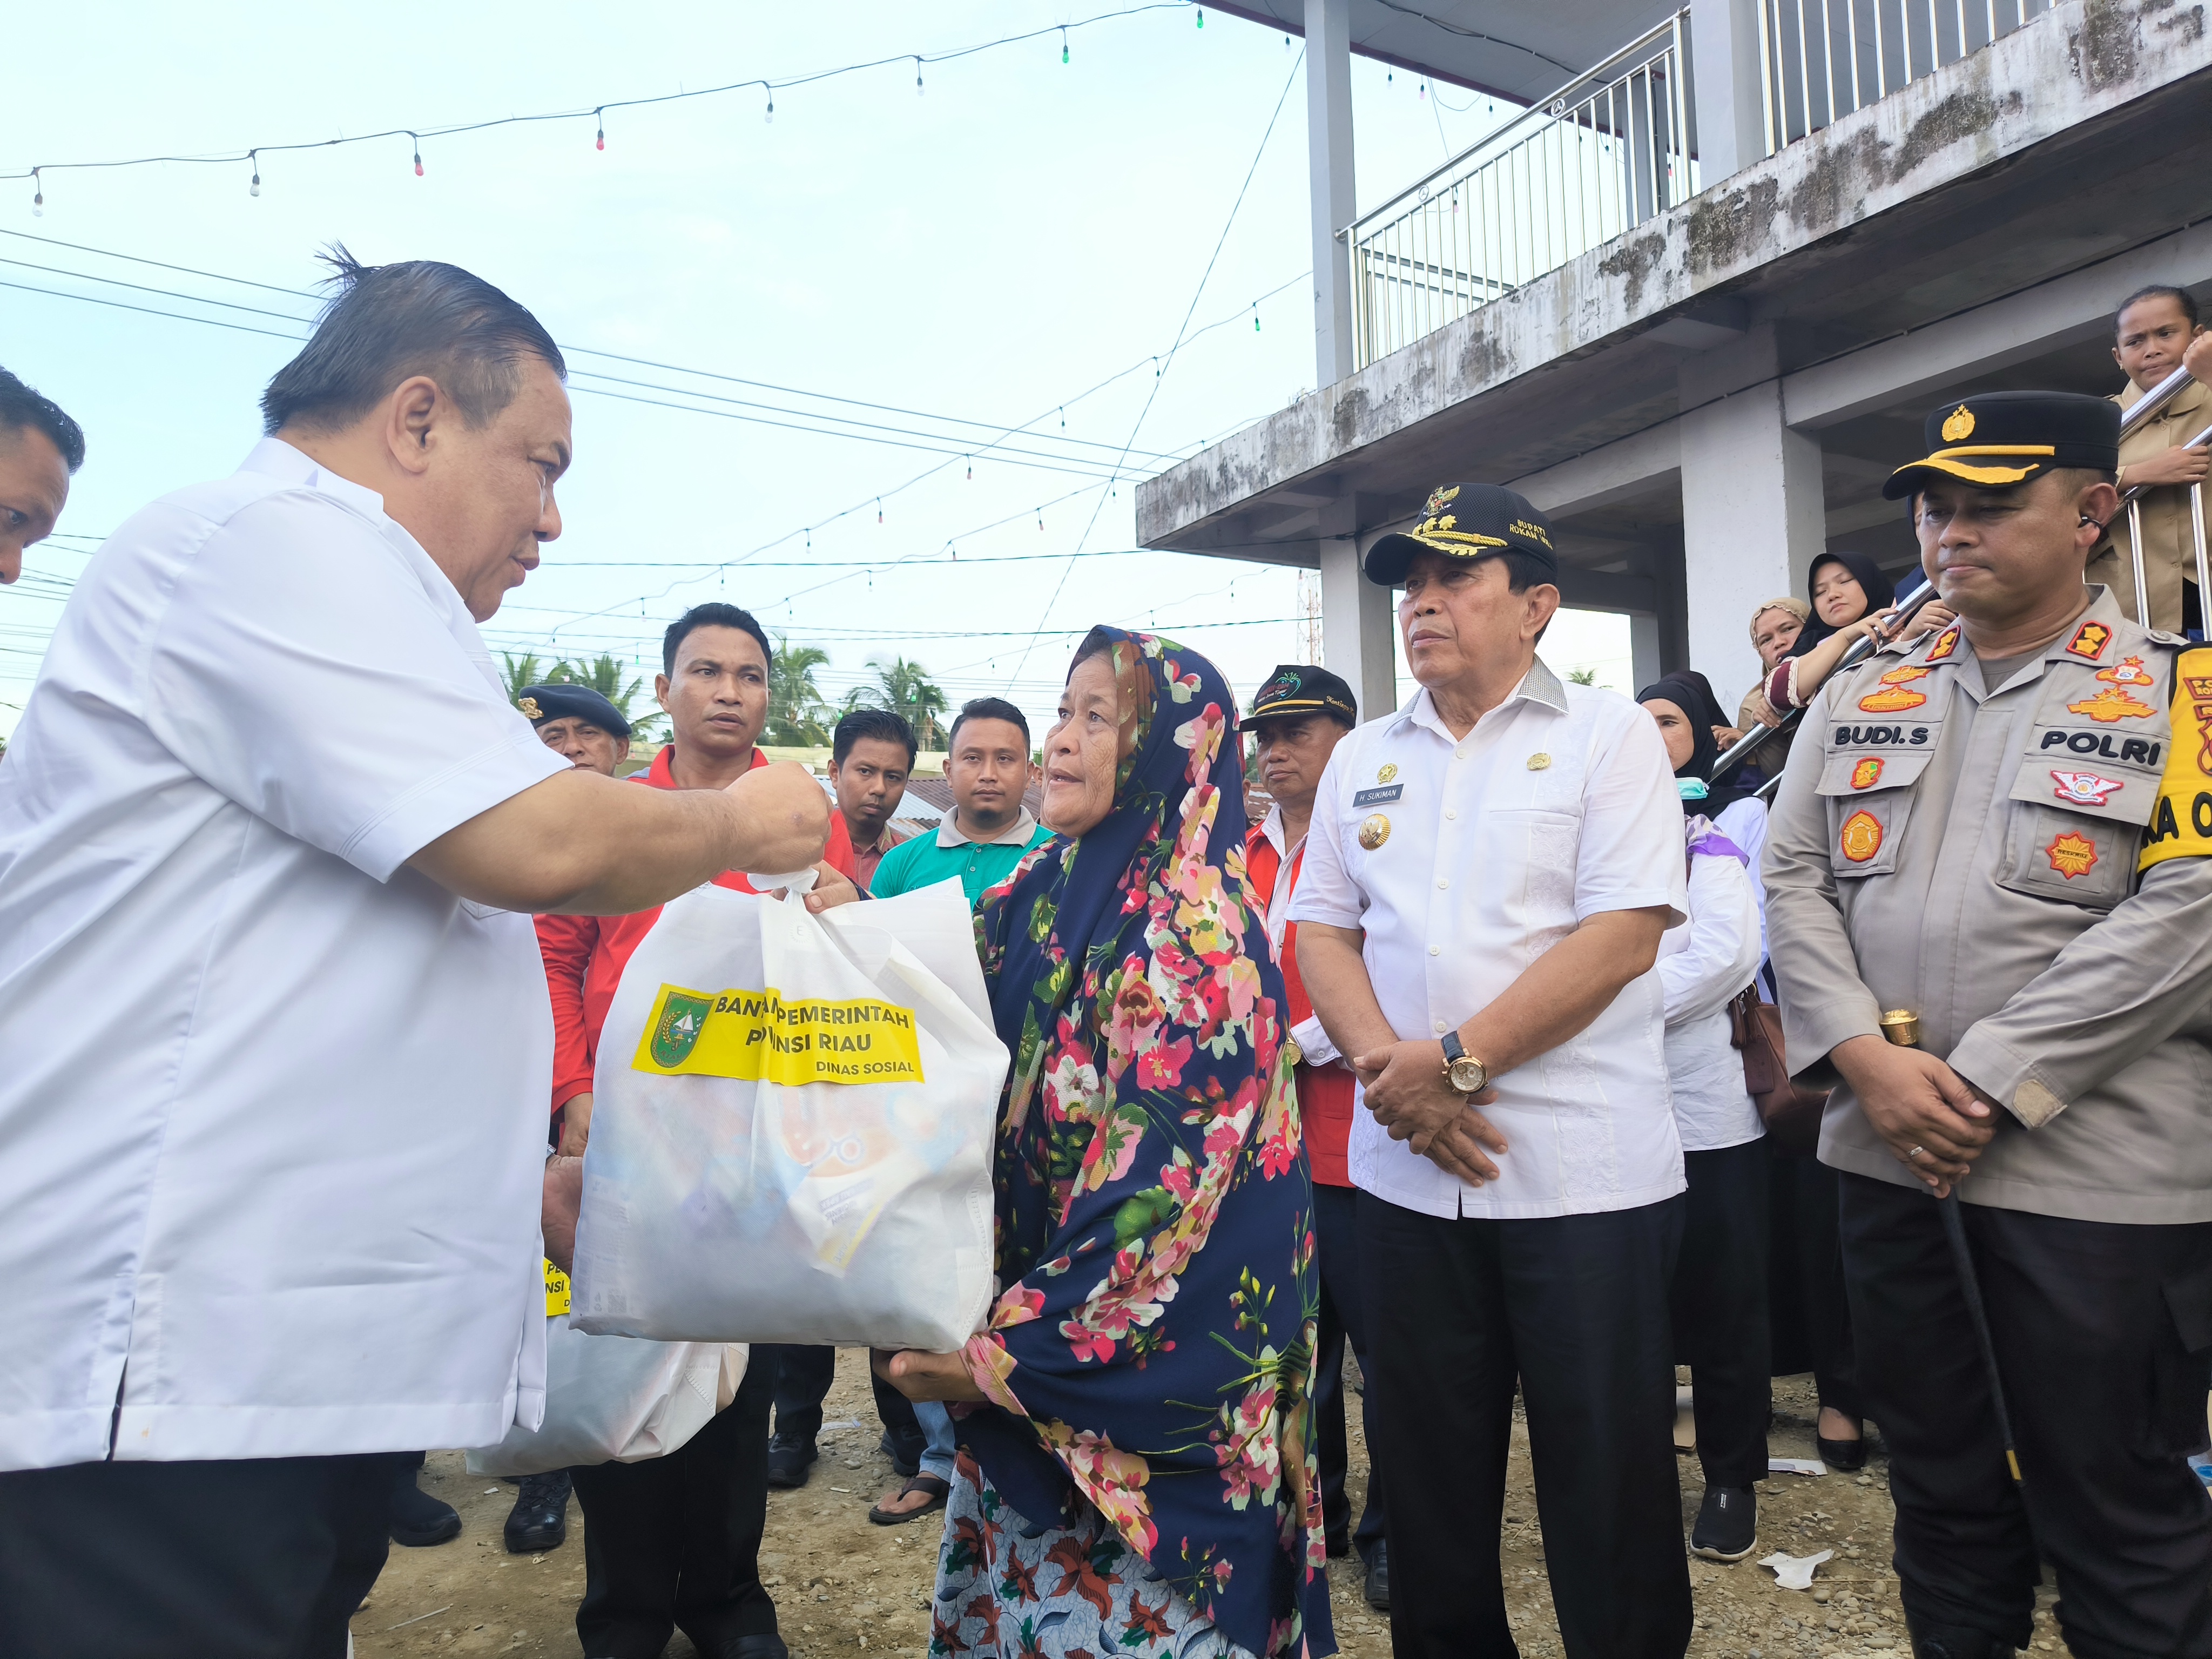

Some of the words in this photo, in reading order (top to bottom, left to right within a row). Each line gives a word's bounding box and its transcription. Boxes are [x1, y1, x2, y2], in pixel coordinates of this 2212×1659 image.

[1509, 523, 1538, 540] ROKAN
[1517, 519, 1546, 537] BUPATI
[2040, 731, 2161, 766] POLRI
[1367, 789, 1397, 801] SUKIMAN
[777, 1006, 909, 1029] PEMERINTAH
[819, 1033, 871, 1052] RIAU
[816, 1061, 859, 1075] DINAS
[863, 1061, 914, 1074] SOSIAL
